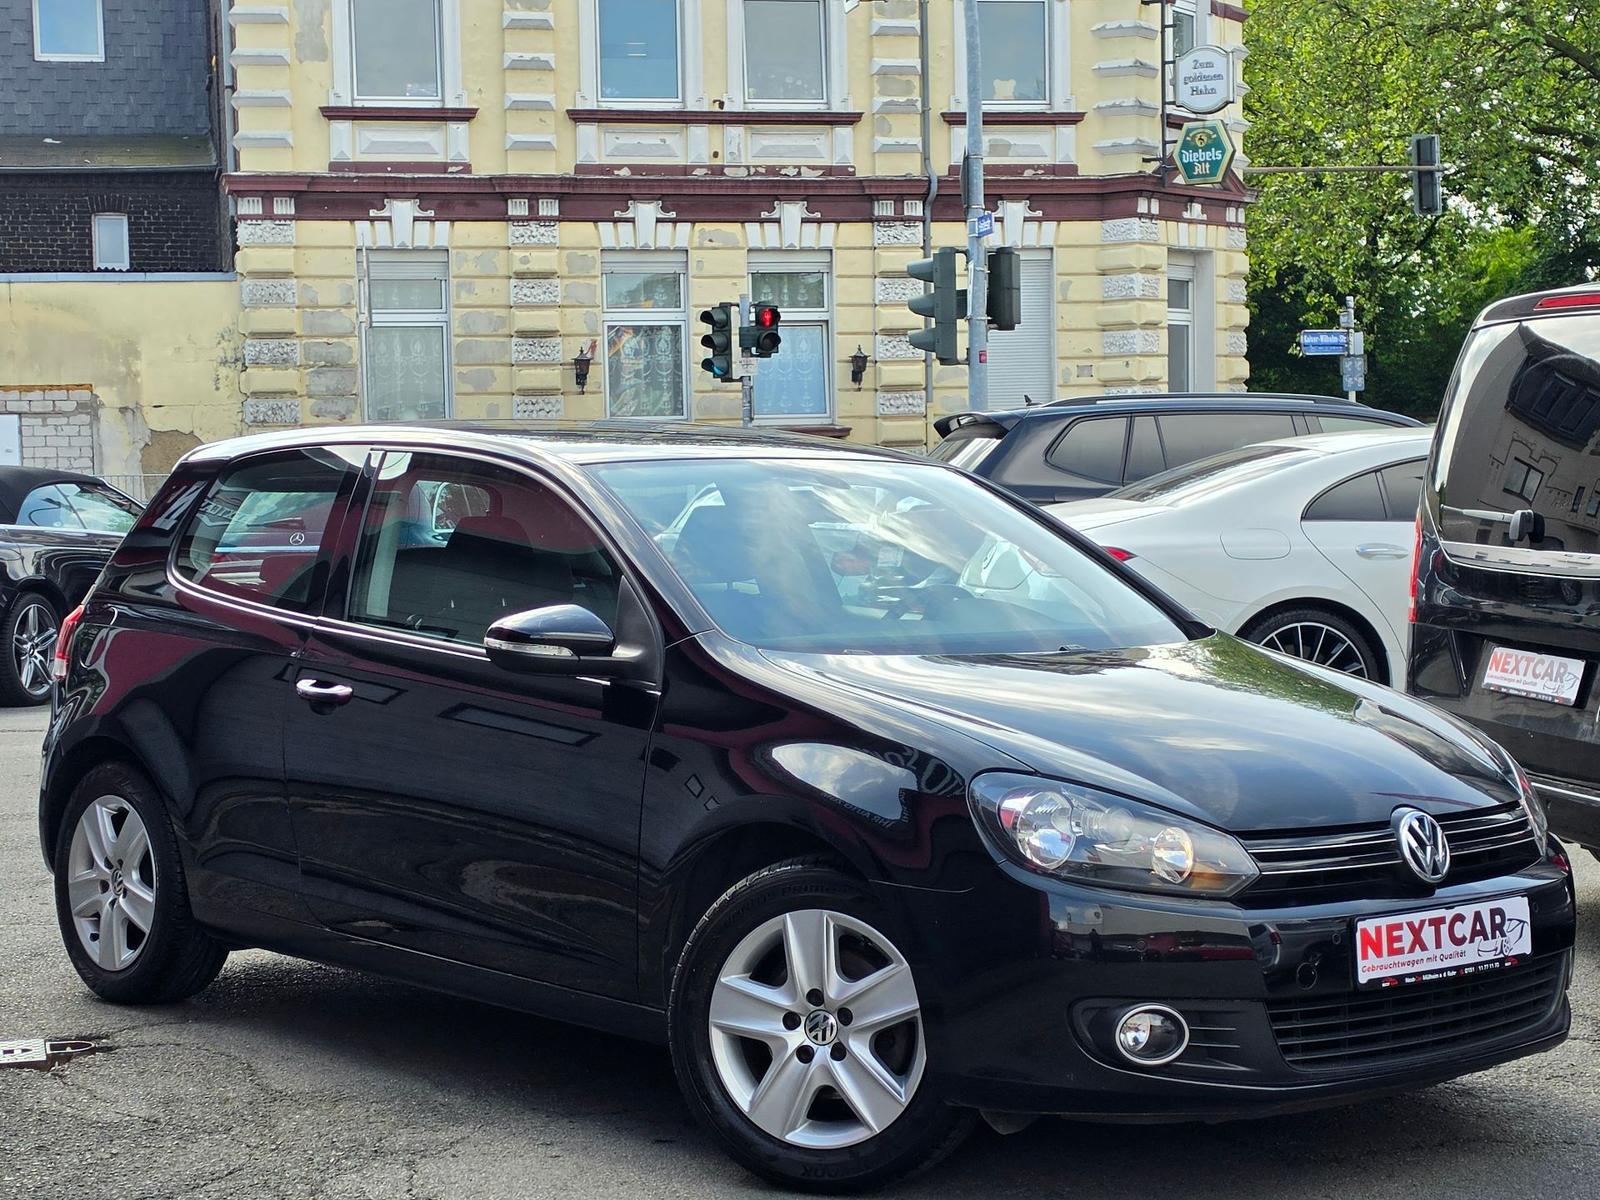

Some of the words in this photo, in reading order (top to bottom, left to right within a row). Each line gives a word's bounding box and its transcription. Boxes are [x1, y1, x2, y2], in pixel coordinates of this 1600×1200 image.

[1192, 59, 1214, 70] Zum
[1183, 73, 1224, 85] goldenen
[1190, 85, 1217, 96] Hahn
[1193, 162, 1211, 175] Alt
[1489, 651, 1568, 684] NEXTCAR
[1359, 907, 1508, 961] NEXTCAR
[1361, 957, 1425, 973] Gebrauchtwagen
[1426, 953, 1438, 963] mit
[1439, 950, 1467, 962] Qualität
